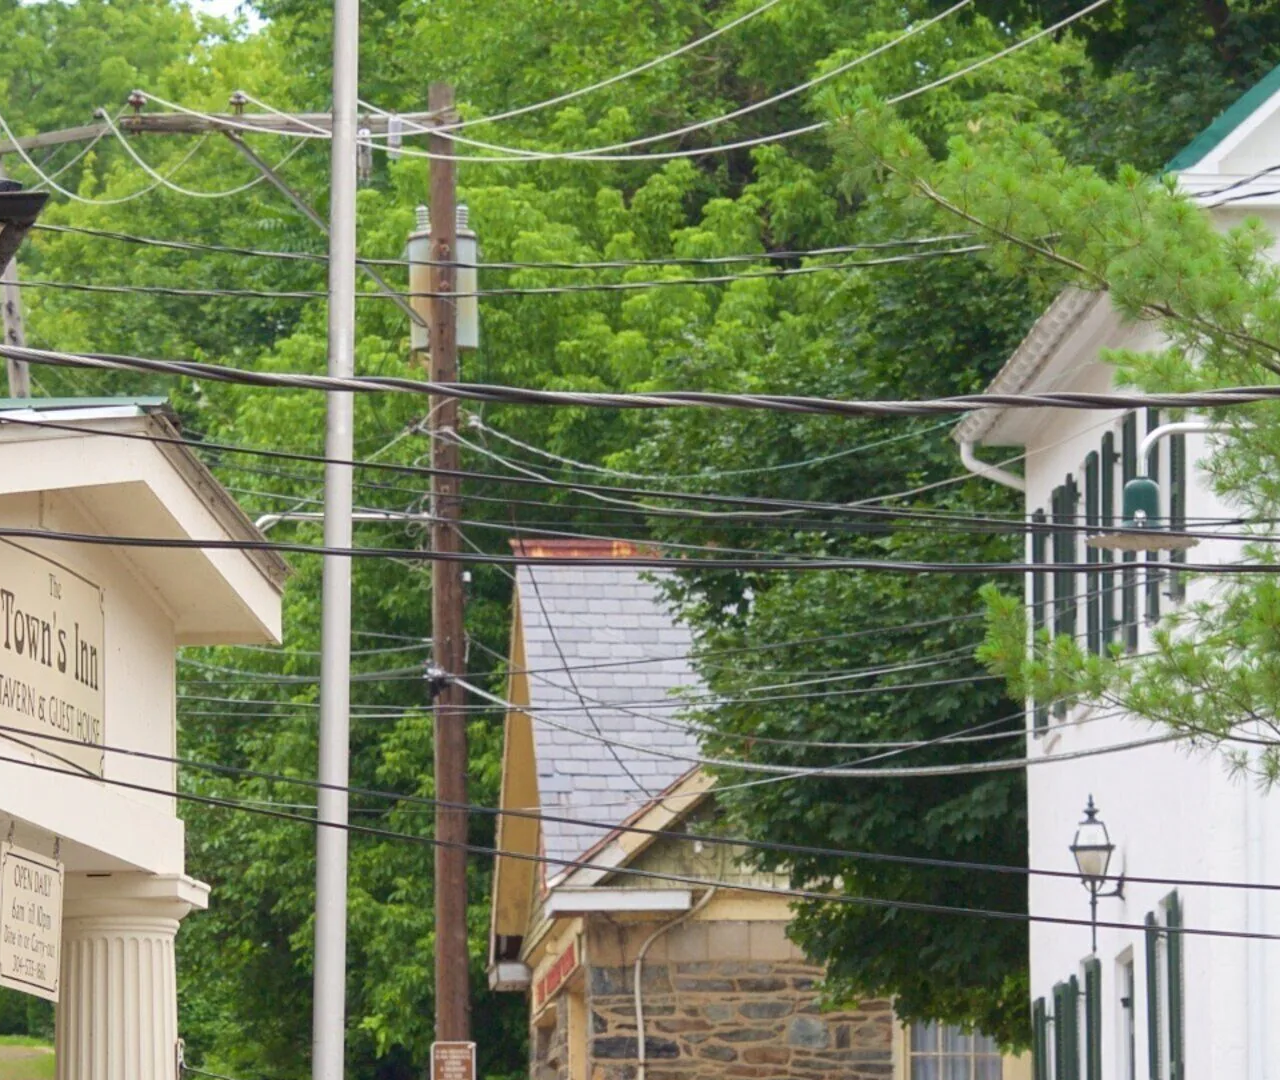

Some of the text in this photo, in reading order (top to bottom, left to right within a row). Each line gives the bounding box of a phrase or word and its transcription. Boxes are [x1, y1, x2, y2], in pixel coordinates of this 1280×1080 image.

[48, 573, 61, 600] The
[0, 588, 98, 691] Town's Inn
[38, 695, 46, 723] &
[48, 696, 74, 733] GUEST
[14, 864, 52, 897] OPEN DAILY
